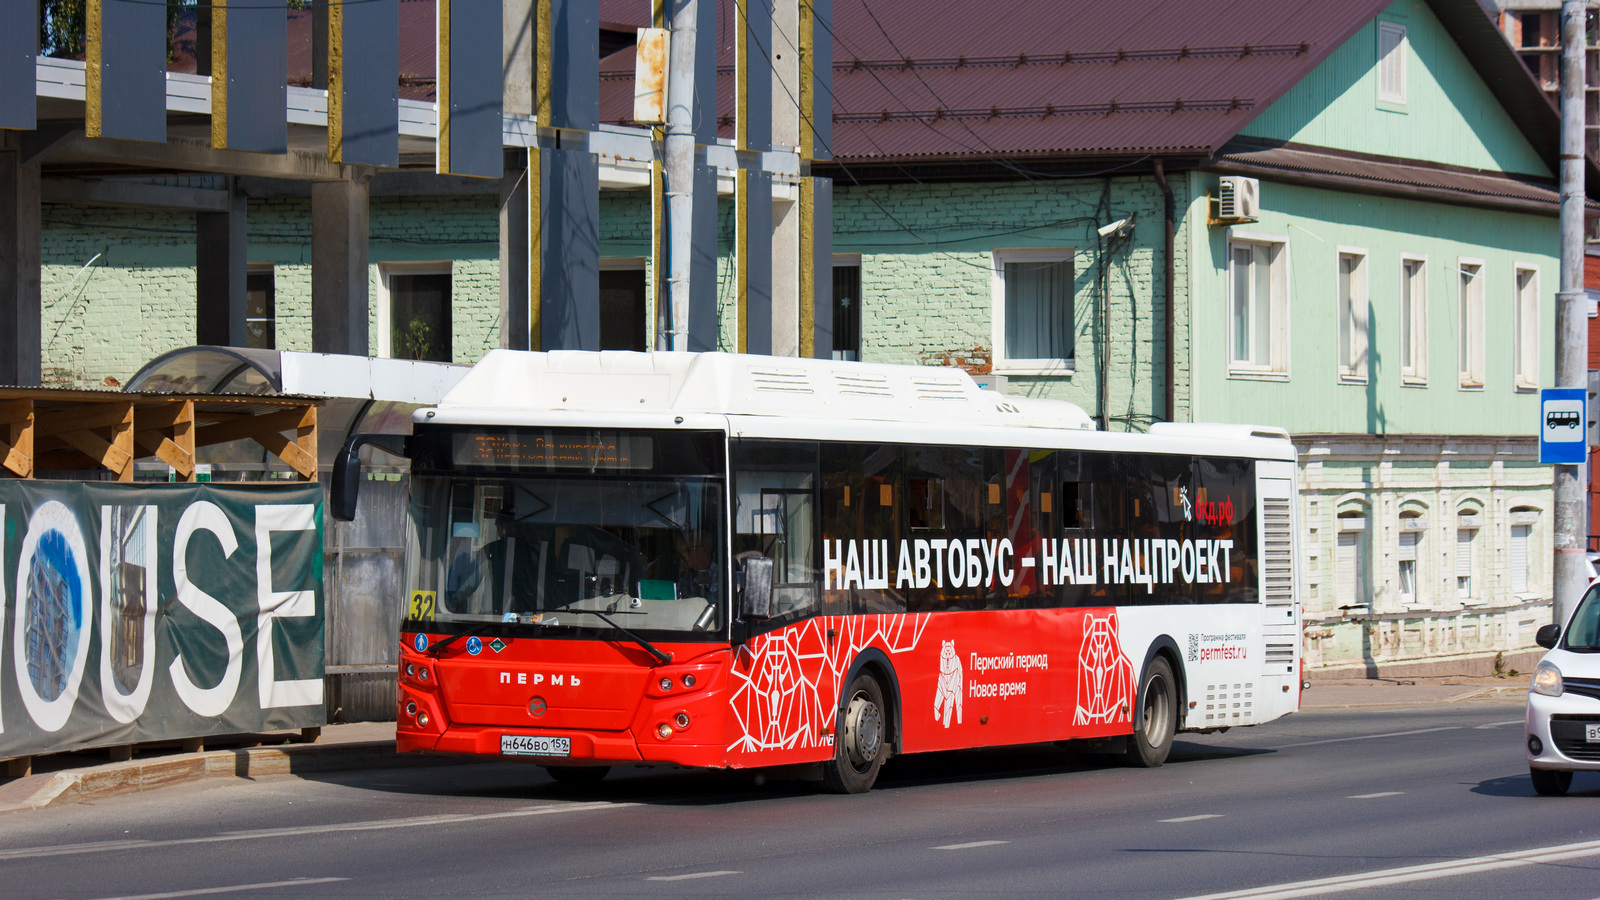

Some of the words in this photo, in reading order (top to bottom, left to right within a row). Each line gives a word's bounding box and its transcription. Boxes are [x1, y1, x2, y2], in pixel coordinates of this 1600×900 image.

[1195, 494, 1234, 526] бкд.рф
[824, 538, 888, 590] НАШ
[896, 537, 1014, 588] АВТОБУС
[1042, 538, 1097, 585] НАШ
[1103, 538, 1234, 594] НАЦПРОЕКТ
[0, 500, 323, 733] OUSE
[411, 594, 434, 621] 32
[970, 652, 1014, 675] Пермский
[1016, 653, 1048, 672] период
[1200, 643, 1247, 665] permfest.ru
[500, 672, 581, 687] ПЕРМЬ
[969, 680, 997, 698] Новое
[999, 681, 1026, 700] время
[550, 738, 567, 749] 159
